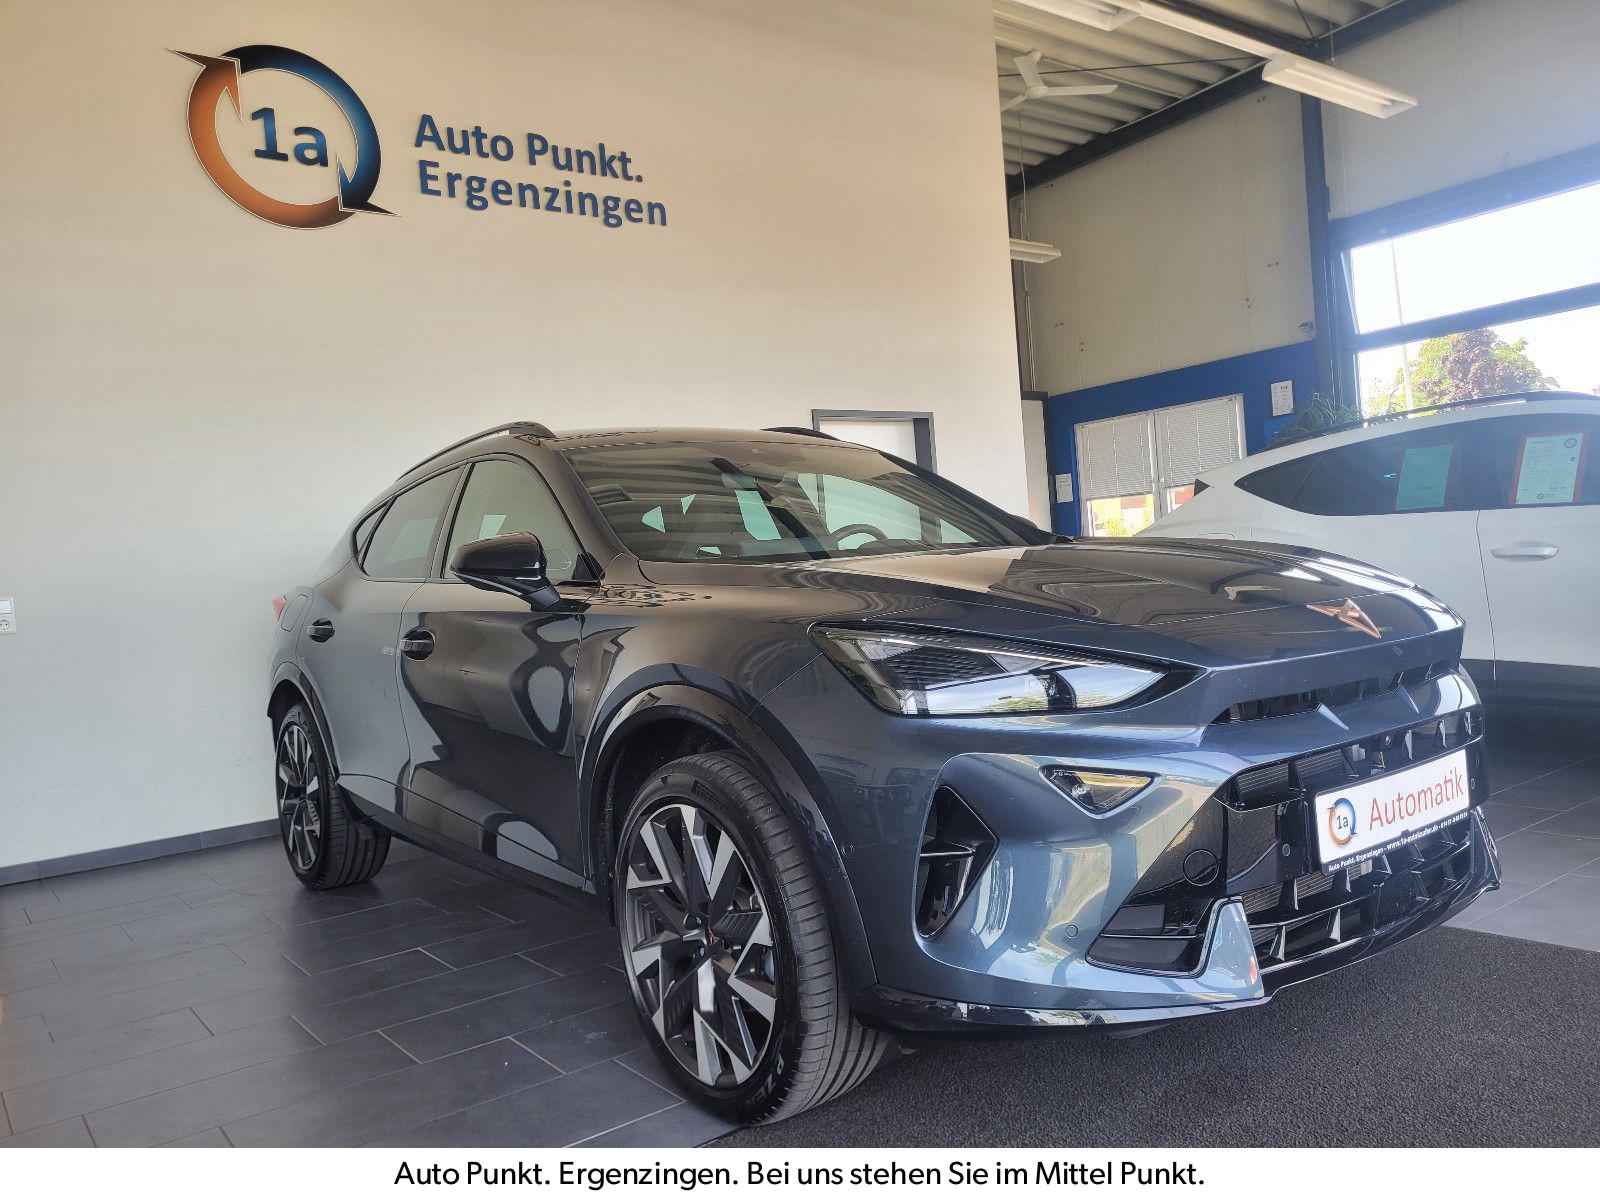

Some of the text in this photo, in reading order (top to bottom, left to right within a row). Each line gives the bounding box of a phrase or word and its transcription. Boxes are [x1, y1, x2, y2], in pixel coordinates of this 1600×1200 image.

[252, 107, 329, 167] 1a
[415, 114, 643, 183] Auto Punkt.
[418, 160, 667, 228] Ergenzingen
[1336, 815, 1349, 830] 1a
[1368, 767, 1464, 832] Automatik
